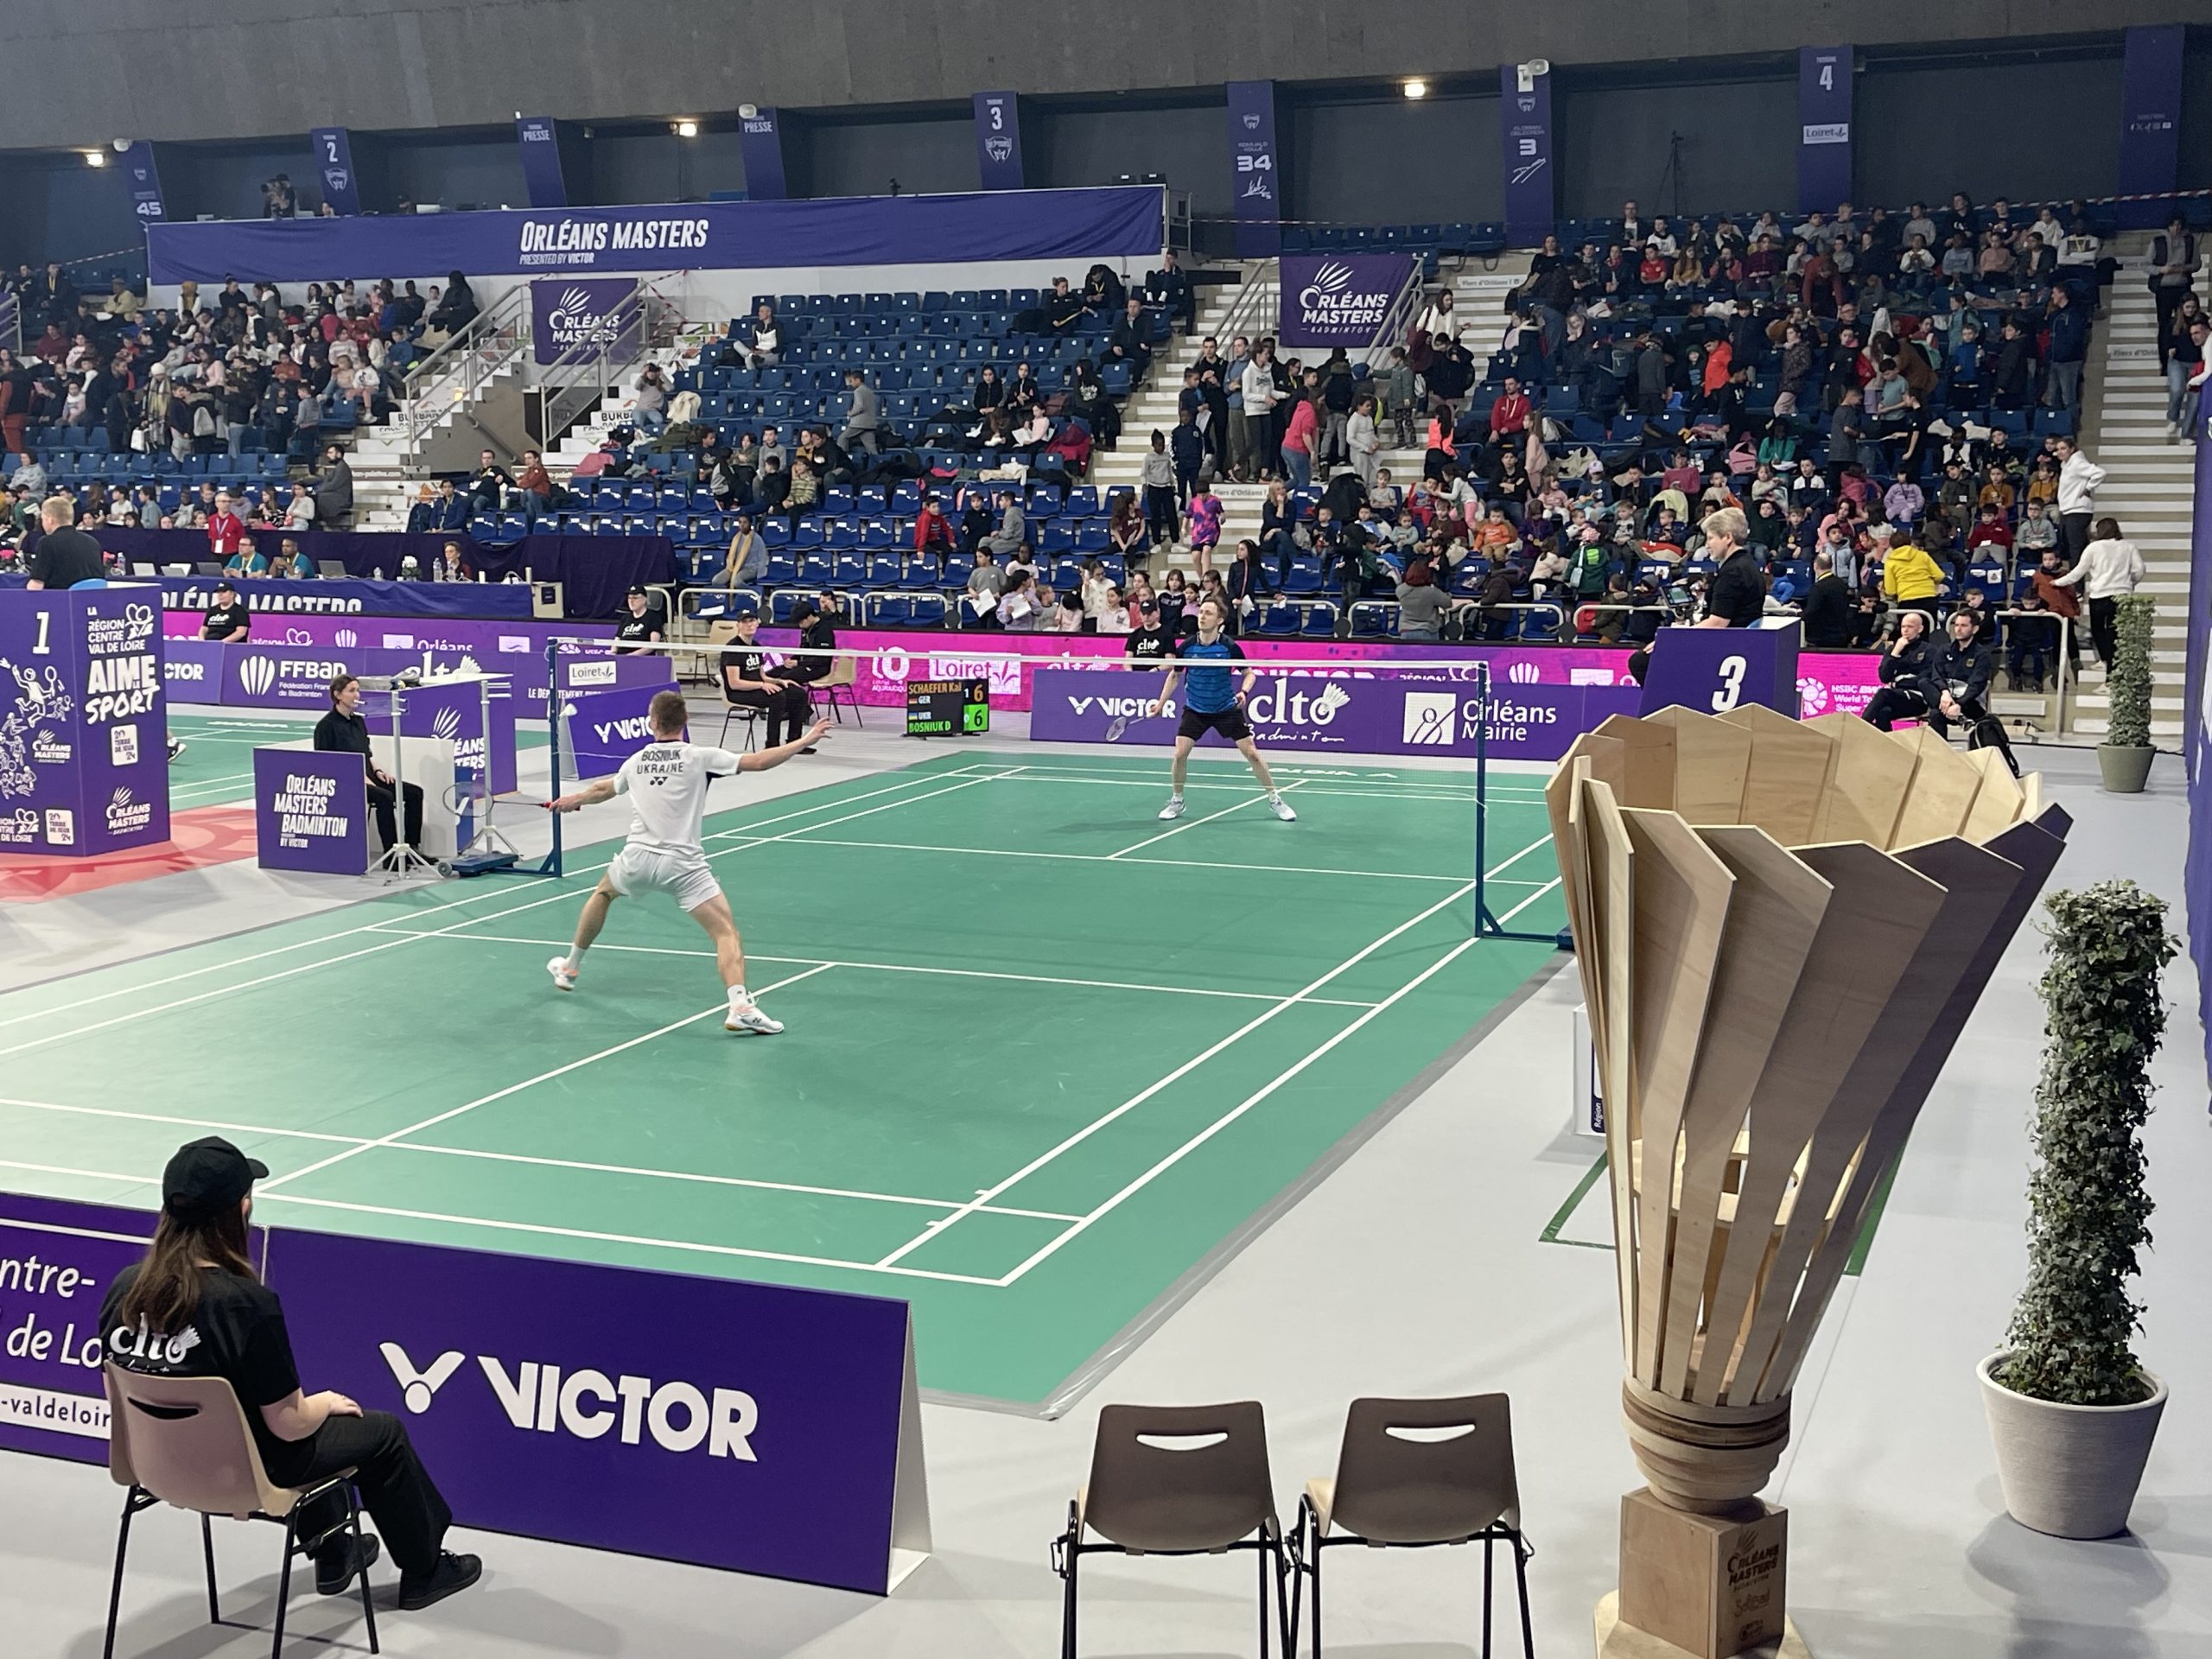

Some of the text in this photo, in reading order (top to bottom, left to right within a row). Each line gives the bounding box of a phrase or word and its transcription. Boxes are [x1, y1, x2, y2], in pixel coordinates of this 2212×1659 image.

[1820, 65, 1833, 91] 4
[744, 121, 772, 133] PRESSE
[990, 106, 1002, 130] 3
[523, 130, 550, 142] PRESSE
[1806, 128, 1834, 137] Loiret
[327, 142, 338, 162] 2
[1519, 138, 1536, 156] 3
[1236, 154, 1272, 172] 34
[136, 201, 162, 216] 45
[520, 219, 709, 252] ORLÉANS MASTERS
[519, 251, 594, 265] PRESENTED BY VICTOR
[1300, 286, 1389, 309] ORLÉANS
[1302, 308, 1383, 325] MASTERS
[1311, 325, 1371, 334] BADMINTON
[32, 611, 50, 654] 1
[88, 619, 125, 632] RÉGION
[88, 630, 124, 644] CENTRE
[88, 639, 145, 654] VAL DE LOIRE
[87, 654, 156, 695] AIME
[572, 667, 602, 678] Loiret
[936, 660, 992, 678] Loiret
[908, 683, 949, 695] SCHAEFER
[963, 688, 969, 698] 1
[974, 683, 984, 702] 6
[1711, 655, 1747, 712] 3
[528, 688, 537, 699] LE
[918, 696, 931, 704] GER
[85, 684, 161, 725] SPORT
[1462, 698, 1557, 724] Orléans
[918, 711, 931, 720] UKR
[974, 709, 983, 727] 6
[908, 721, 951, 734] BOSNIUK D
[34, 750, 71, 760] MASTERS
[641, 749, 681, 761] BOSNIUK
[637, 762, 683, 774] UKRAINE
[286, 773, 336, 797] ORLÉANS
[274, 792, 327, 816] MASTERS
[108, 814, 150, 830] MASTERS
[282, 813, 347, 837] BADMINTON
[12, 835, 33, 843] LOIRE
[6, 1313, 102, 1369] de Lo
[477, 1355, 760, 1463] VICTOR
[1728, 1557, 1777, 1586] MASTERS
